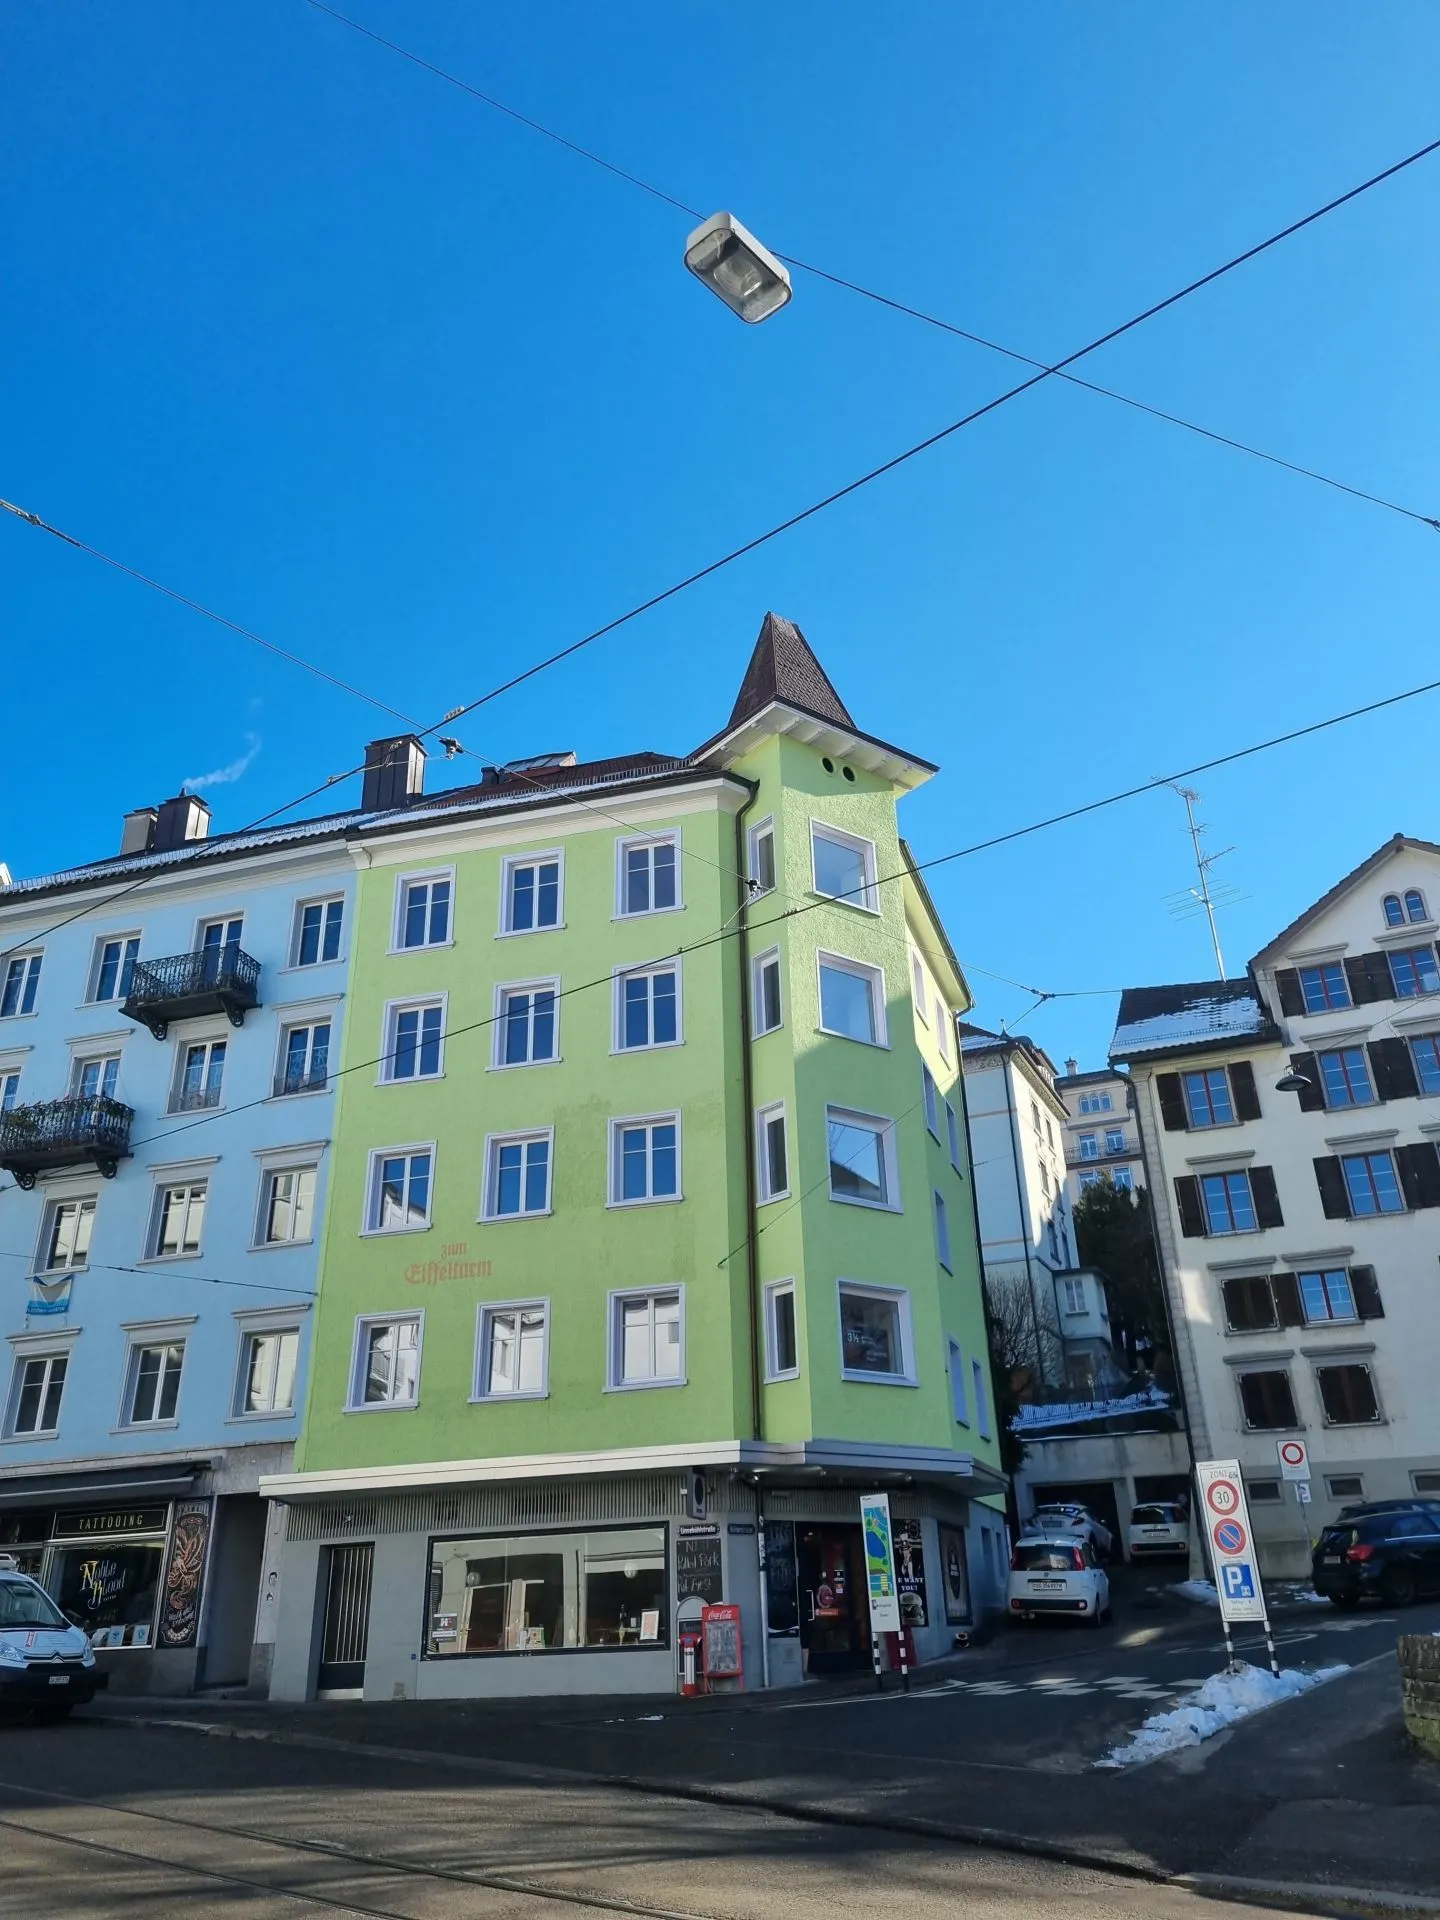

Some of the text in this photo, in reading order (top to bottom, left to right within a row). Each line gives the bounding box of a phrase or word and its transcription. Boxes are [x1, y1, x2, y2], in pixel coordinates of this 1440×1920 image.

[441, 1242, 467, 1259] zum
[404, 1260, 492, 1285] Eiffelturm
[1209, 1469, 1229, 1479] ZONE
[1215, 1490, 1230, 1505] 30
[79, 1514, 143, 1530] TATTOOING
[79, 1560, 118, 1591] Noble
[1225, 1566, 1243, 1594] P
[87, 1568, 127, 1610] Blood
